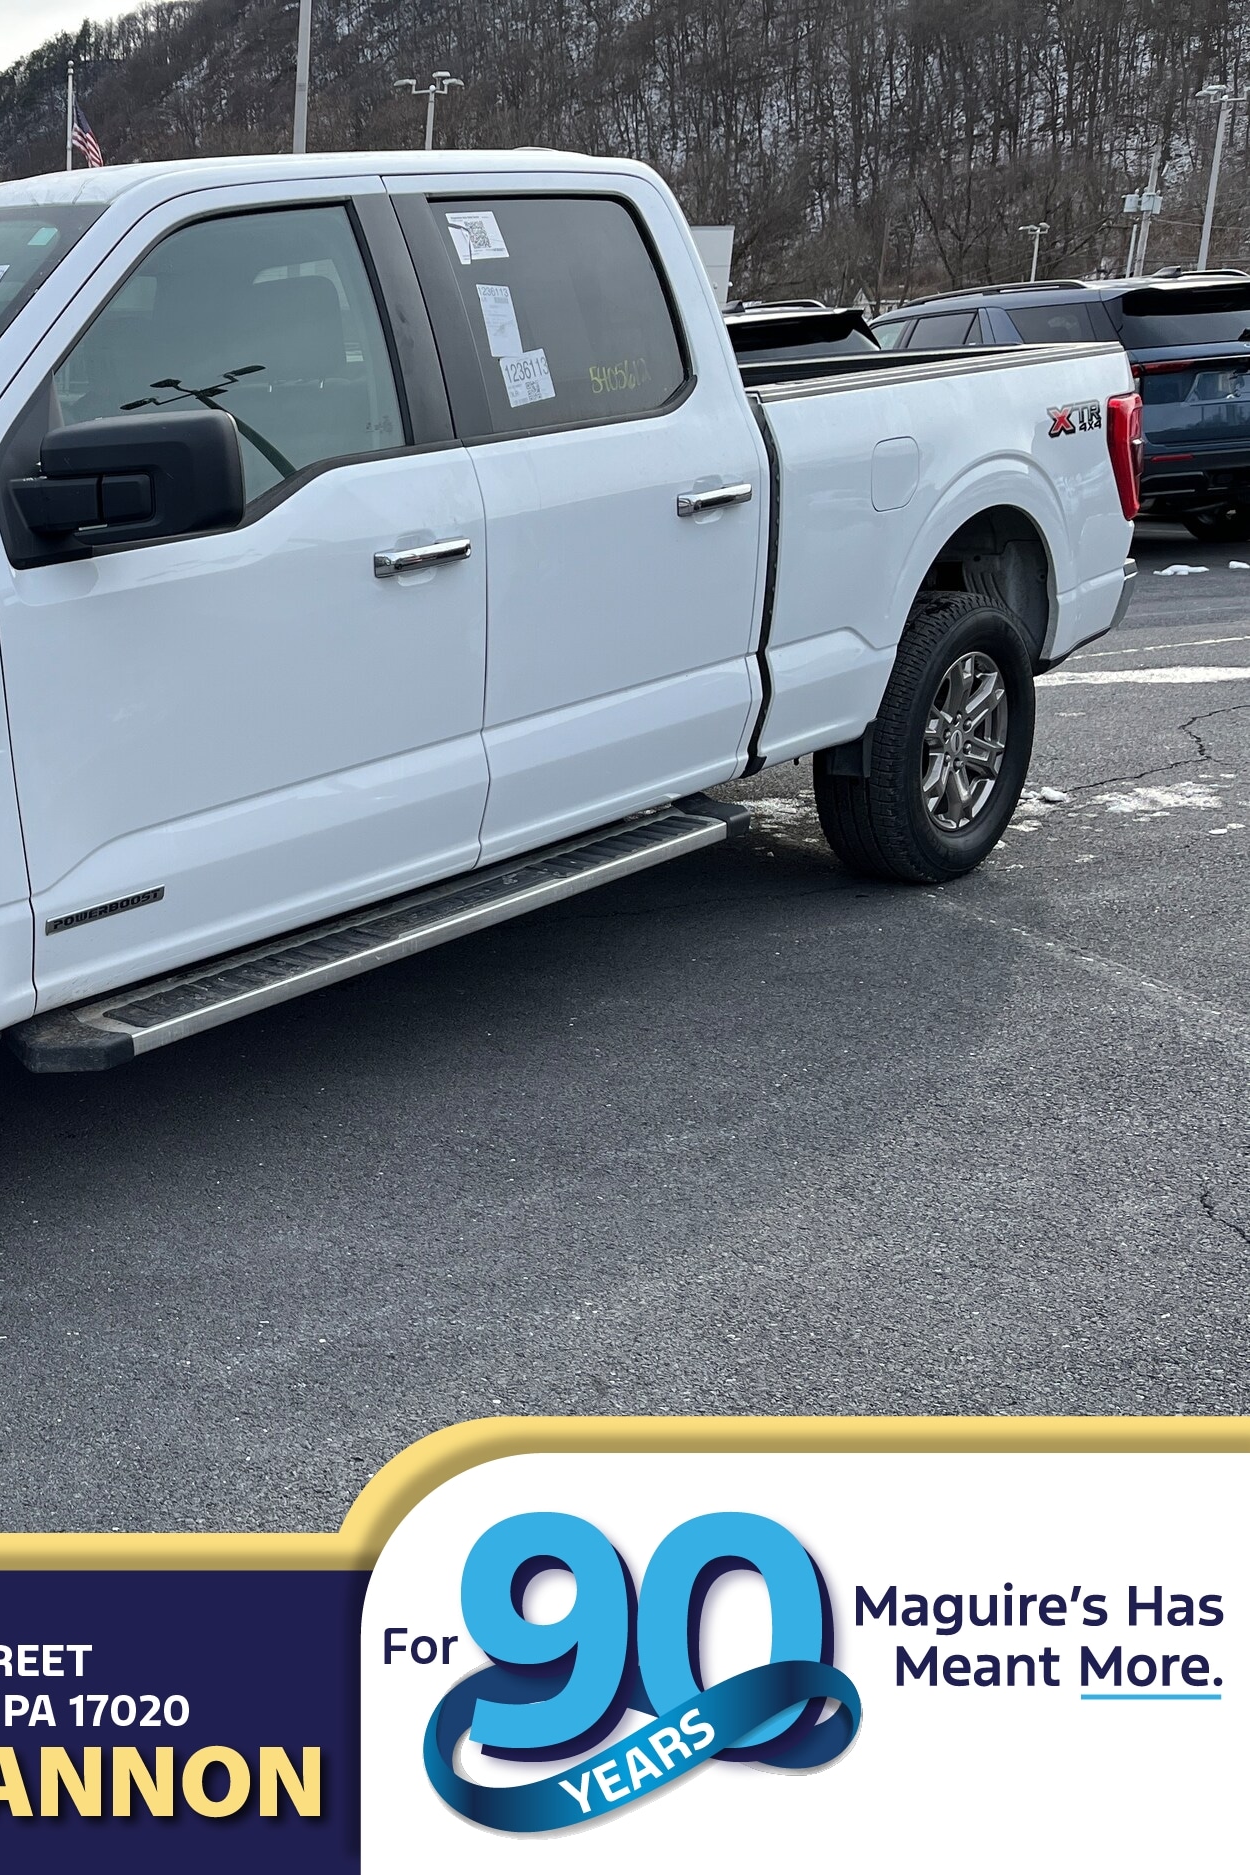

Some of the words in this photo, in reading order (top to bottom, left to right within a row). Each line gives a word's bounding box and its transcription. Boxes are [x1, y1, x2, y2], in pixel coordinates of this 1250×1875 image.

[505, 357, 549, 383] 1236113
[1047, 399, 1102, 438] XTR
[53, 889, 161, 930] POWERBOOST
